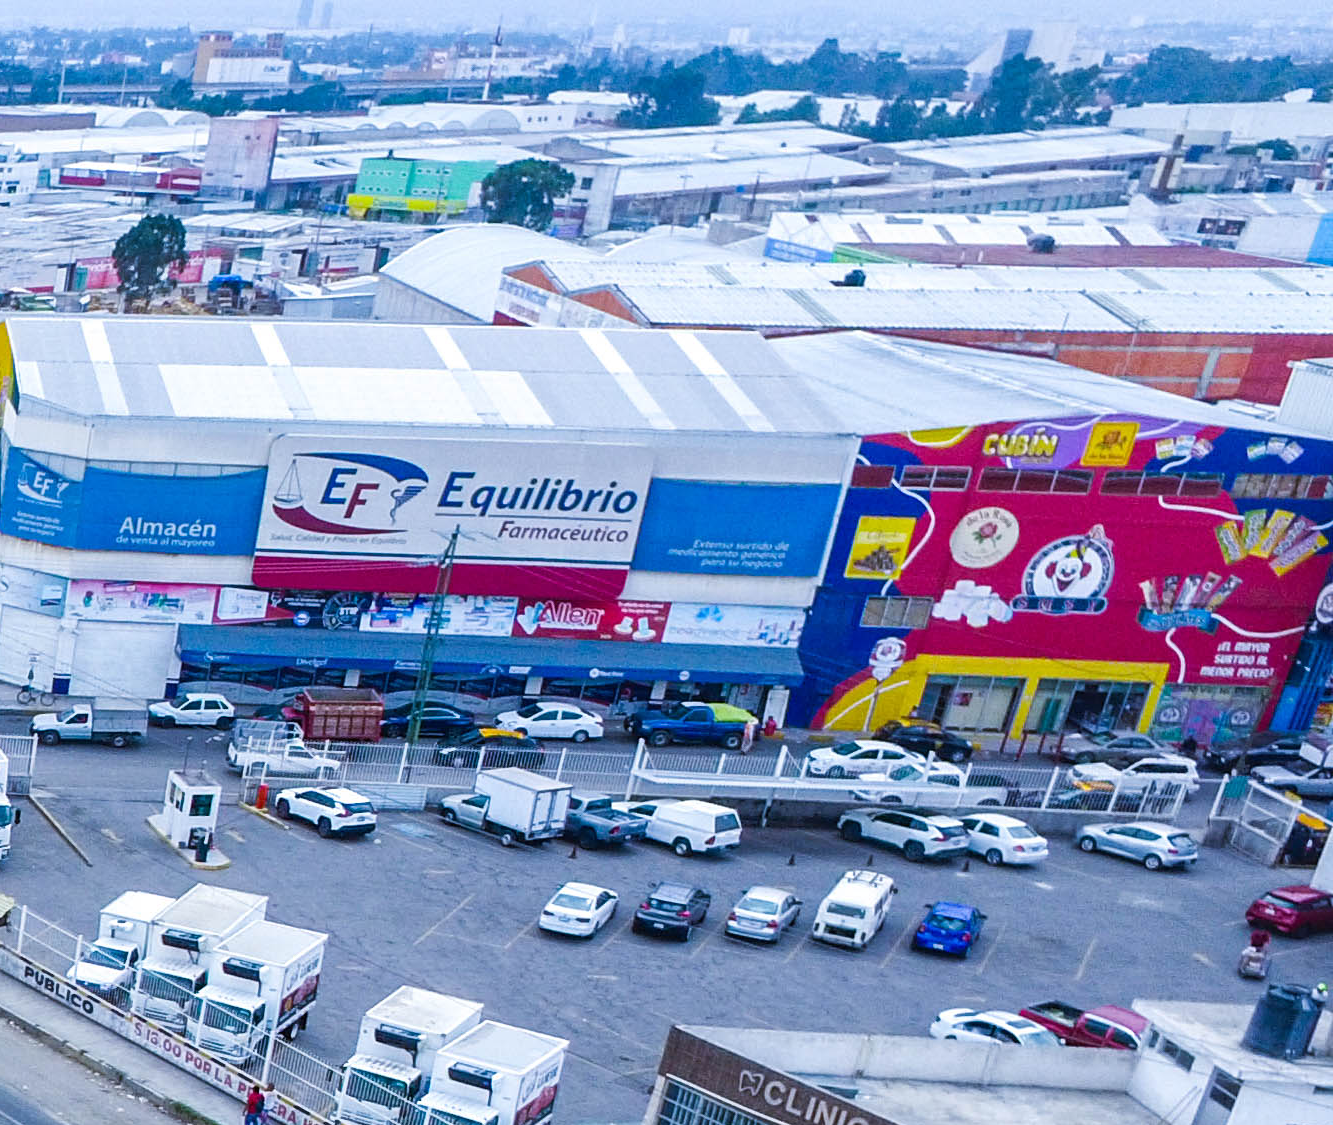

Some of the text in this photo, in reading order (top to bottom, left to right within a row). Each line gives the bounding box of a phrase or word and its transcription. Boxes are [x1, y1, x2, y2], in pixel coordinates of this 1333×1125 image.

[436, 471, 639, 517] Equilibrio
[119, 516, 217, 538] Almacén
[497, 520, 630, 544] Farmacéutico
[116, 535, 129, 545] de
[131, 537, 158, 545] venta
[160, 537, 171, 546] al
[1199, 666, 1235, 677] MENOR
[1214, 654, 1268, 666] SURTIDO AL
[24, 966, 94, 1014] PUBLICO
[185, 1051, 212, 1074] POR
[214, 1067, 232, 1089] LA
